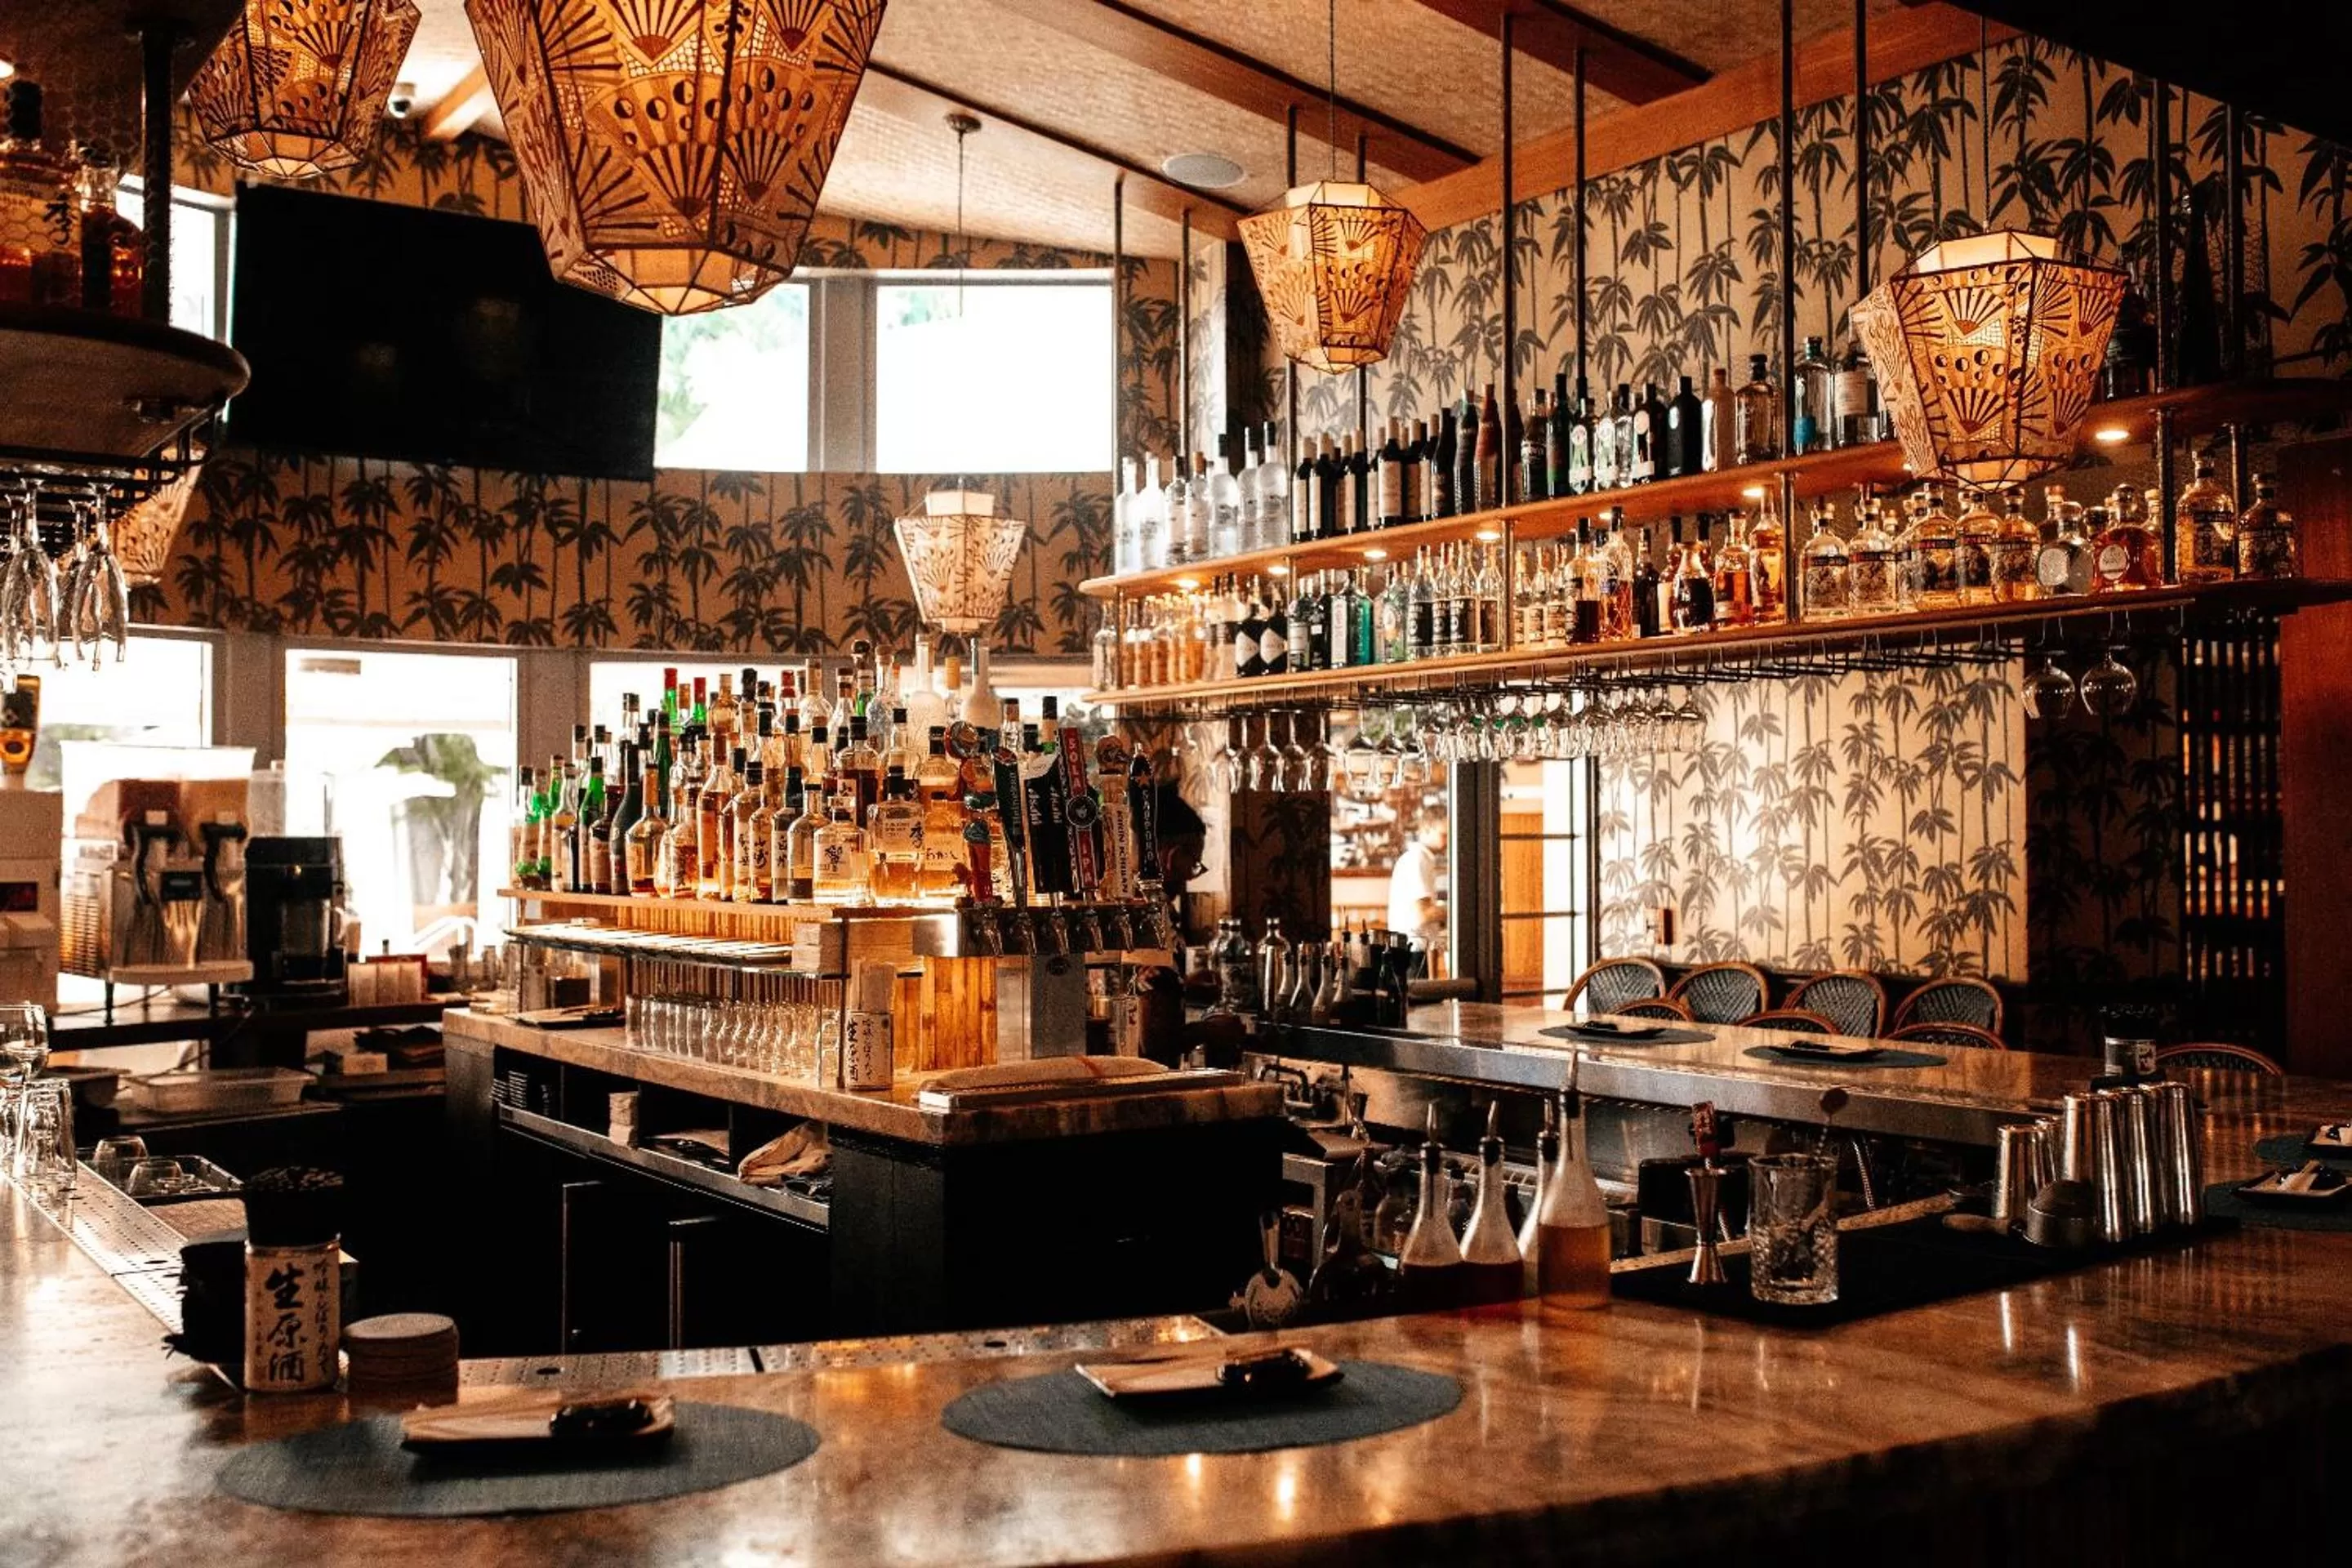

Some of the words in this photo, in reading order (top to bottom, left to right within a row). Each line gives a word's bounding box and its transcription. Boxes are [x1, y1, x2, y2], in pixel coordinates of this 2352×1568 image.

[1116, 809, 1125, 843] KIRIN
[1142, 789, 1154, 861] SAPPORO
[265, 1263, 307, 1382] 生原酒
